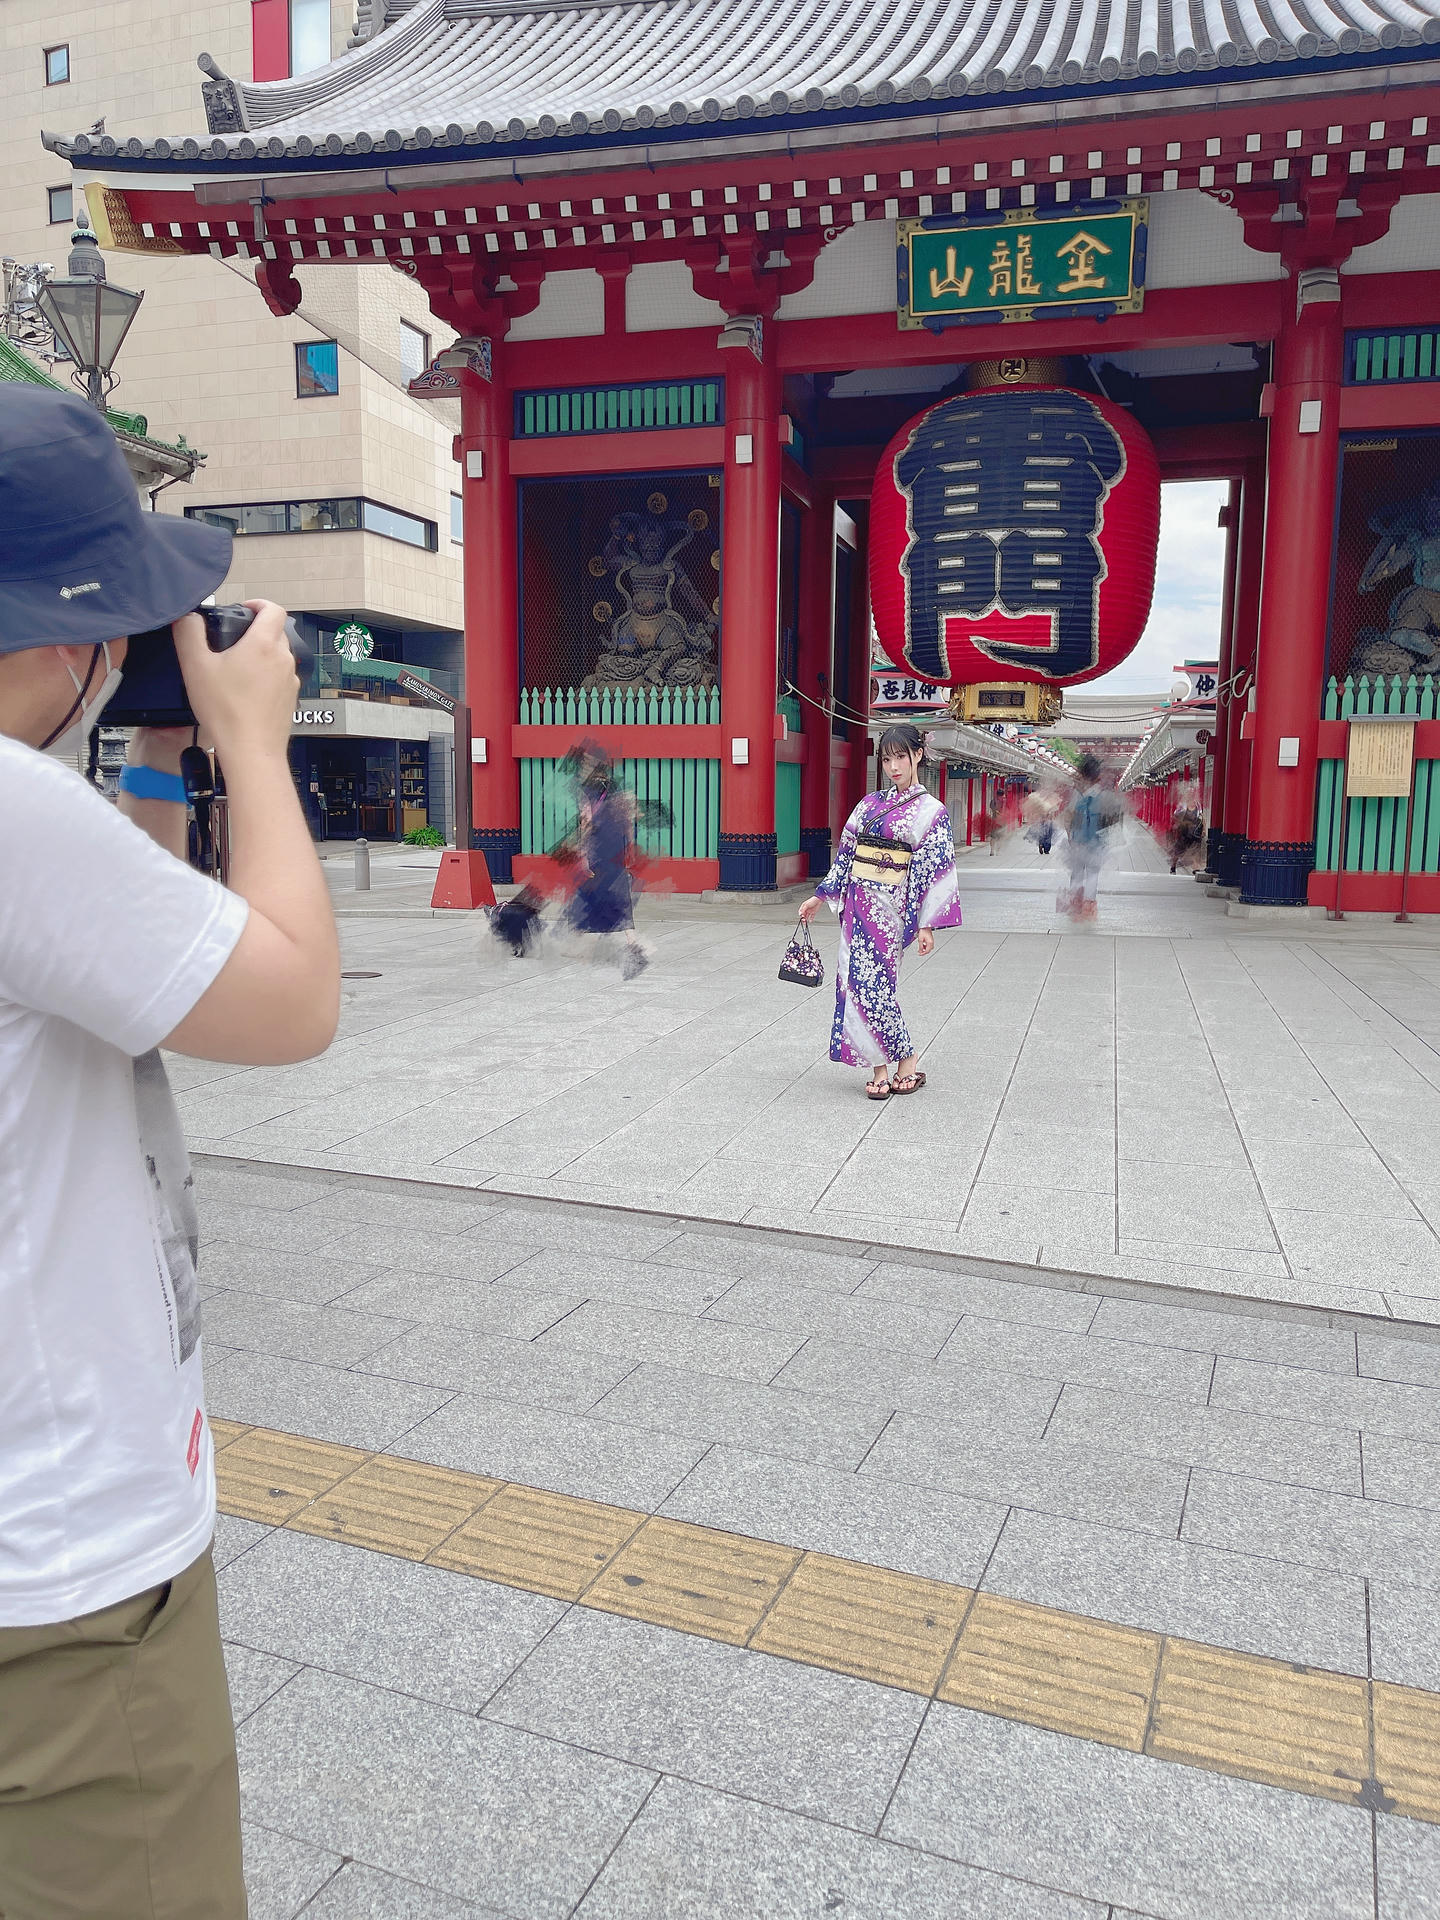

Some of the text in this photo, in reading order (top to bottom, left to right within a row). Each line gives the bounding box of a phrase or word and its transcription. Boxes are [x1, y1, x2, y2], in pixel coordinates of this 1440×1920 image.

[893, 388, 1128, 681] 雷門
[406, 676, 441, 700] KAMINARIMON
[440, 696, 455, 708] GATE
